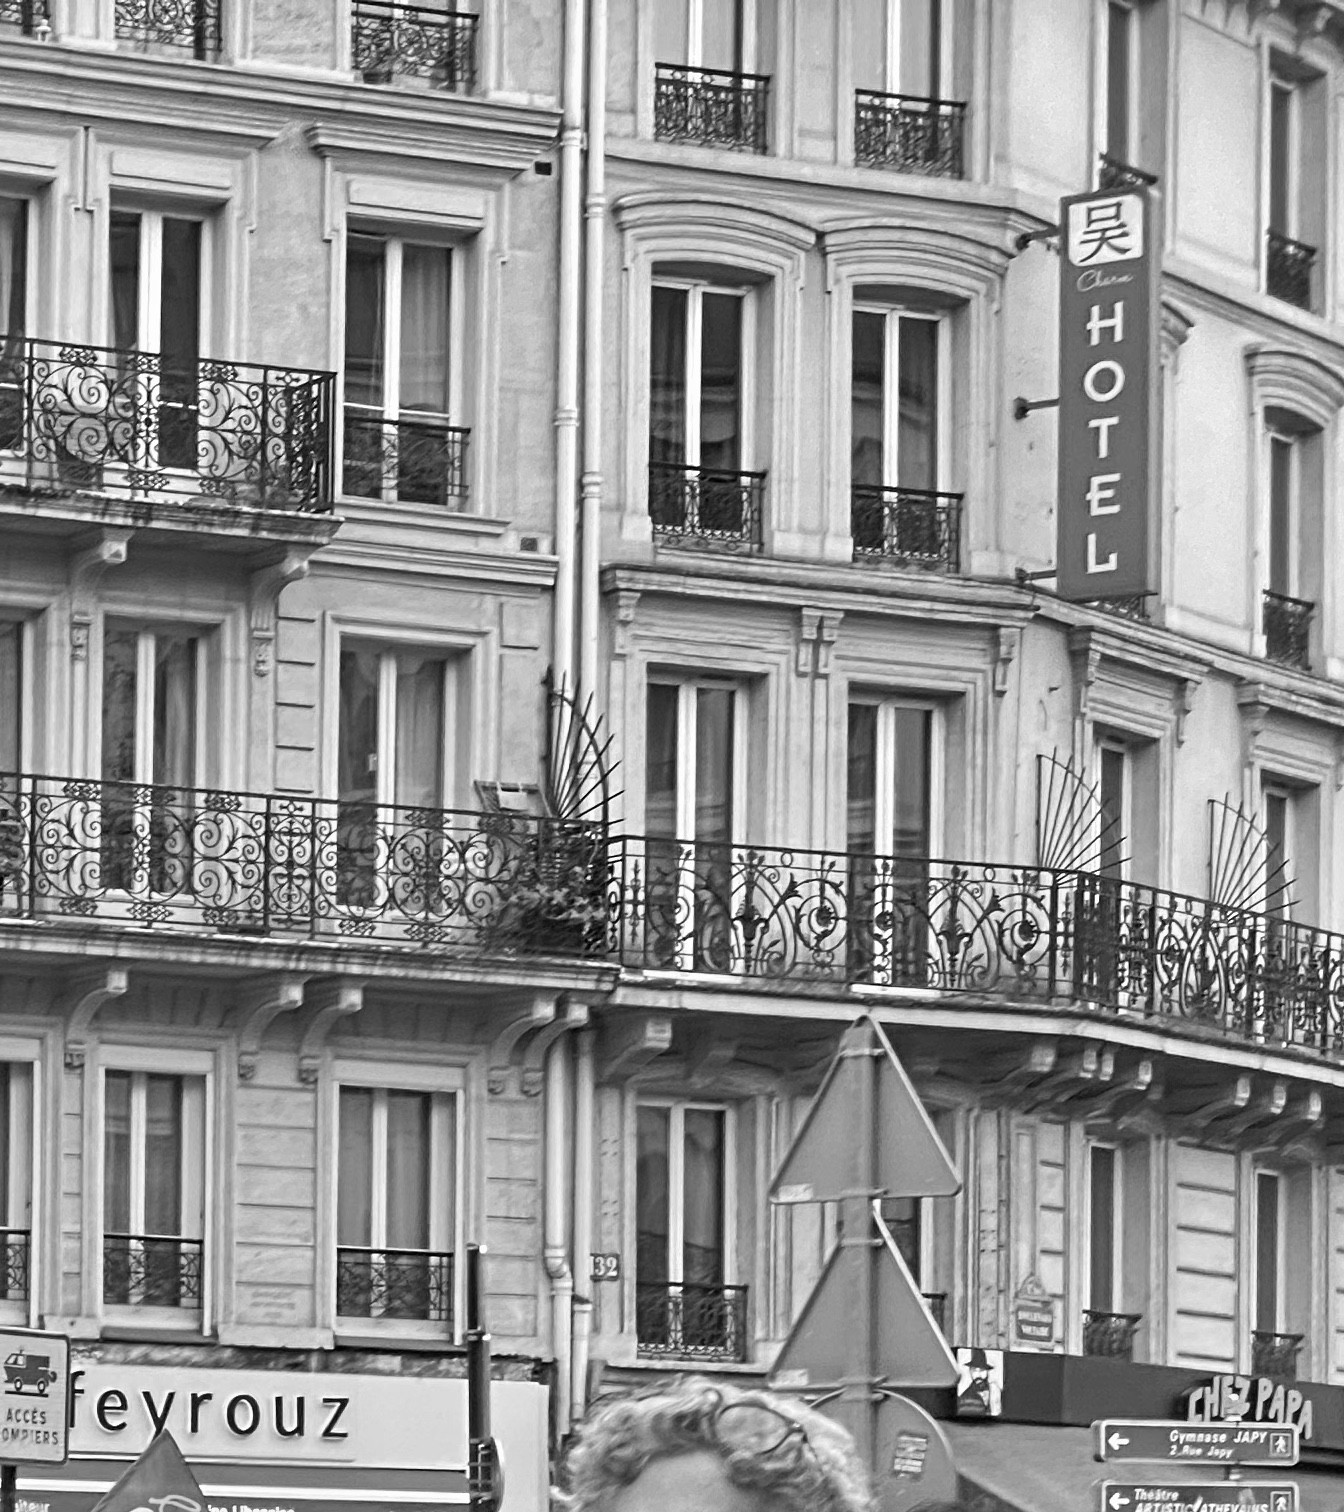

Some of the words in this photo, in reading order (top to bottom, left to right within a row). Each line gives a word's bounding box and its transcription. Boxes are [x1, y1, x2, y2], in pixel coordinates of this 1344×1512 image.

[1083, 301, 1126, 575] HOTEL
[70, 1370, 349, 1440] feyrouz
[1255, 1377, 1313, 1440] PAPA
[1169, 1429, 1228, 1445] Gymnase
[1233, 1430, 1268, 1444] JAPY
[1207, 1446, 1234, 1458] Japy
[1134, 1488, 1180, 1501] Théâtre
